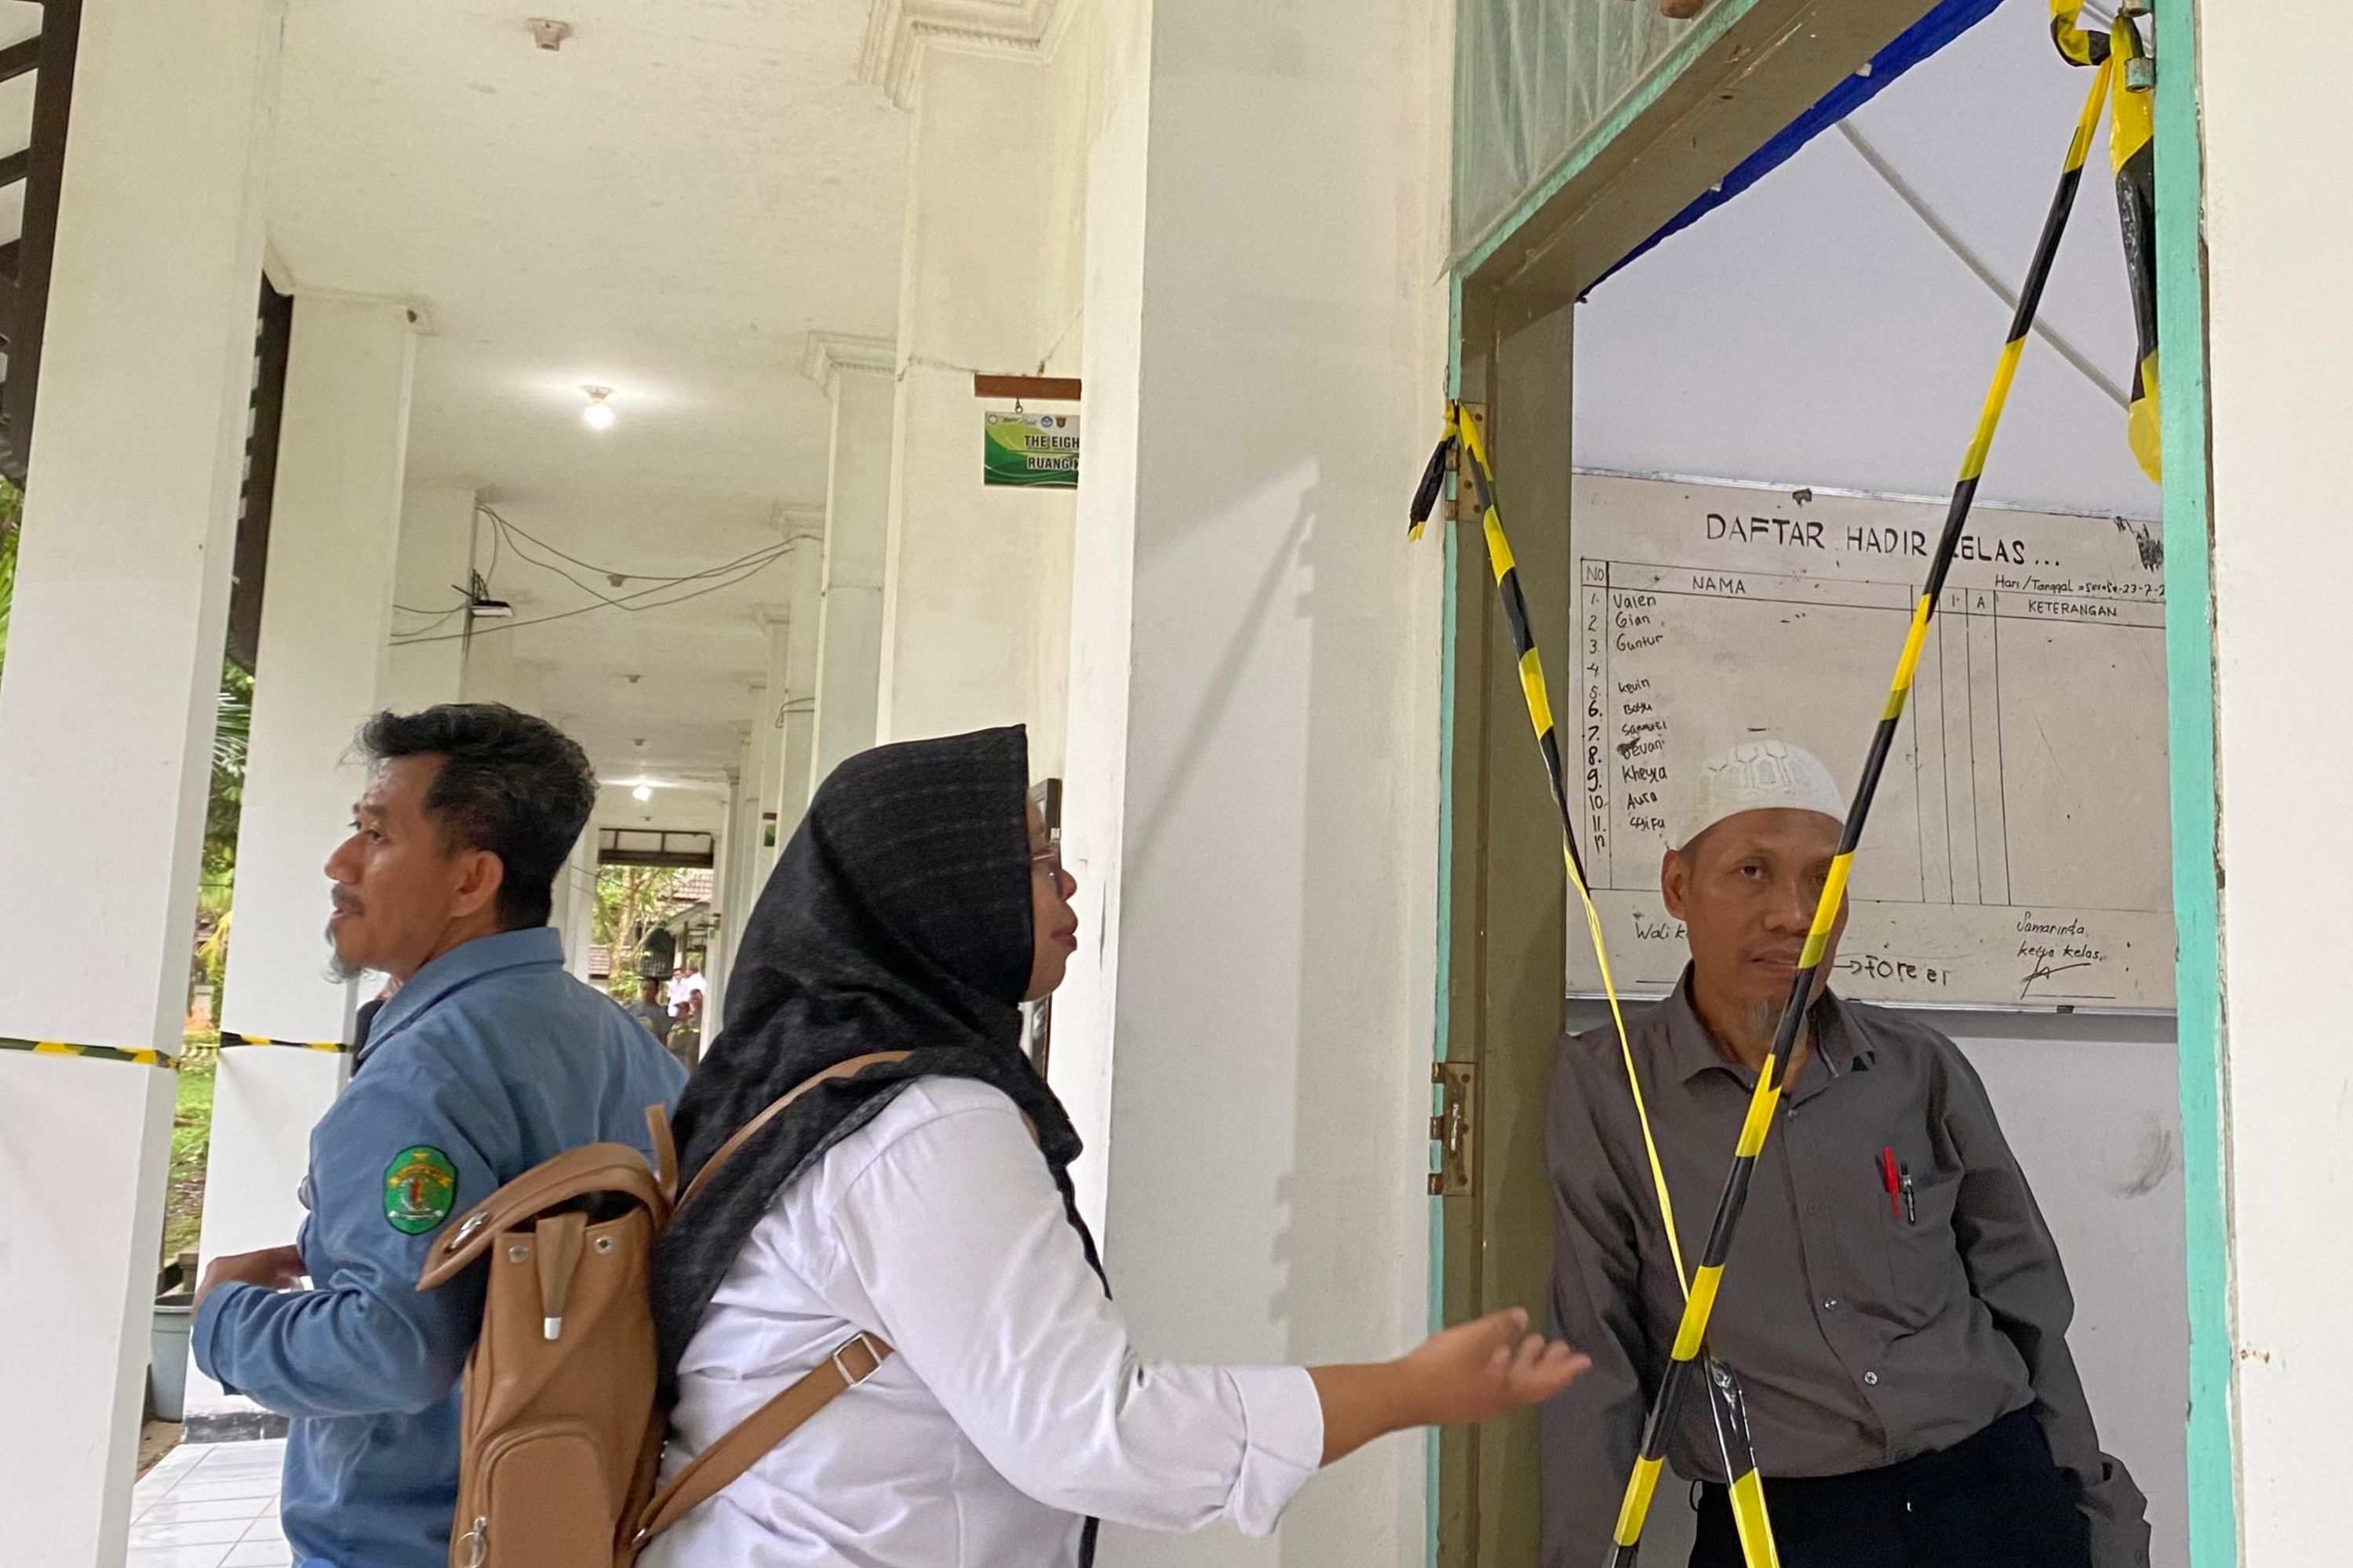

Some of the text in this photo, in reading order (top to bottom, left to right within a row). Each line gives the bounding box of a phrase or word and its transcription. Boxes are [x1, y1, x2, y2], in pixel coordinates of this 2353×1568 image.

[1024, 435, 1080, 449] THE EIGH
[1028, 457, 1070, 470] RUANG
[1706, 513, 1826, 549] DAFTAR
[1846, 524, 1928, 557] HADIR
[1586, 566, 1605, 582] NO
[1692, 575, 1747, 595] NAMA
[1976, 595, 1986, 609] A
[2027, 598, 2118, 617] KETERANGAN
[1615, 610, 1651, 628] Gian
[1615, 632, 1664, 652] Guntur
[1626, 791, 1659, 810] Aura
[1634, 922, 1670, 940] Wali
